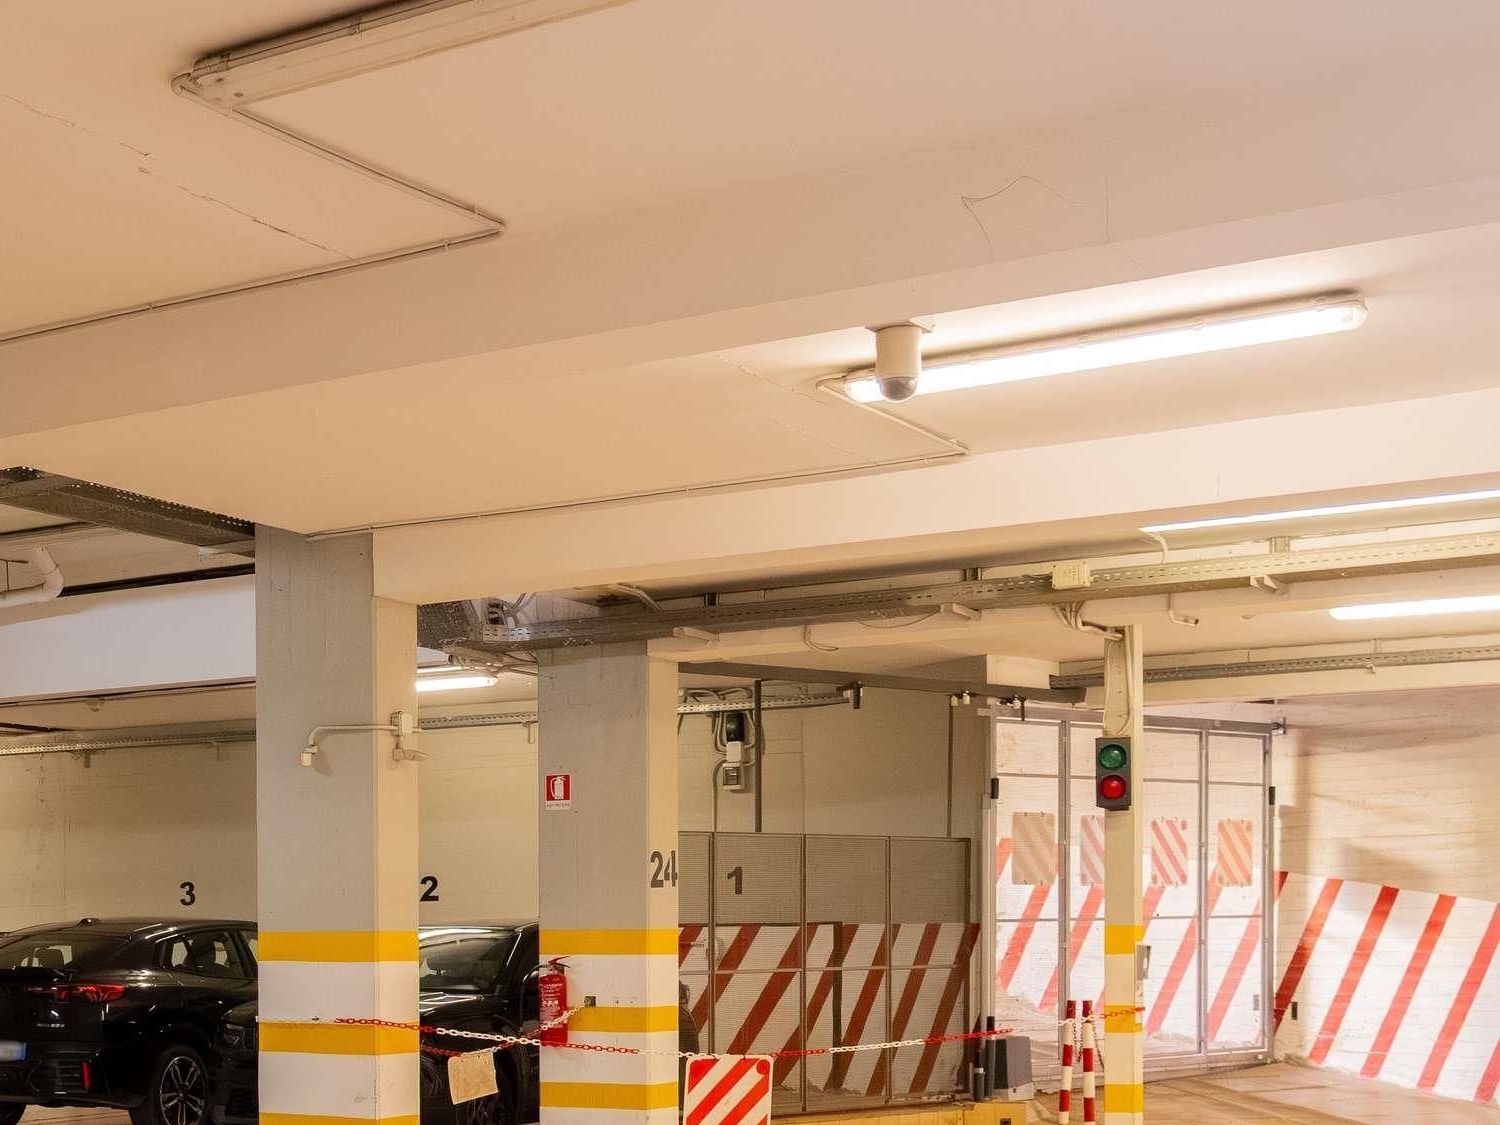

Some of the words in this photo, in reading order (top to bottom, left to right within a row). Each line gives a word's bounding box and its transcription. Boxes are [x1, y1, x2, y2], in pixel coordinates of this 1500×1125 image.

[651, 850, 677, 888] 24
[727, 866, 743, 895] 1
[180, 881, 196, 906] 3
[420, 875, 439, 902] 2
